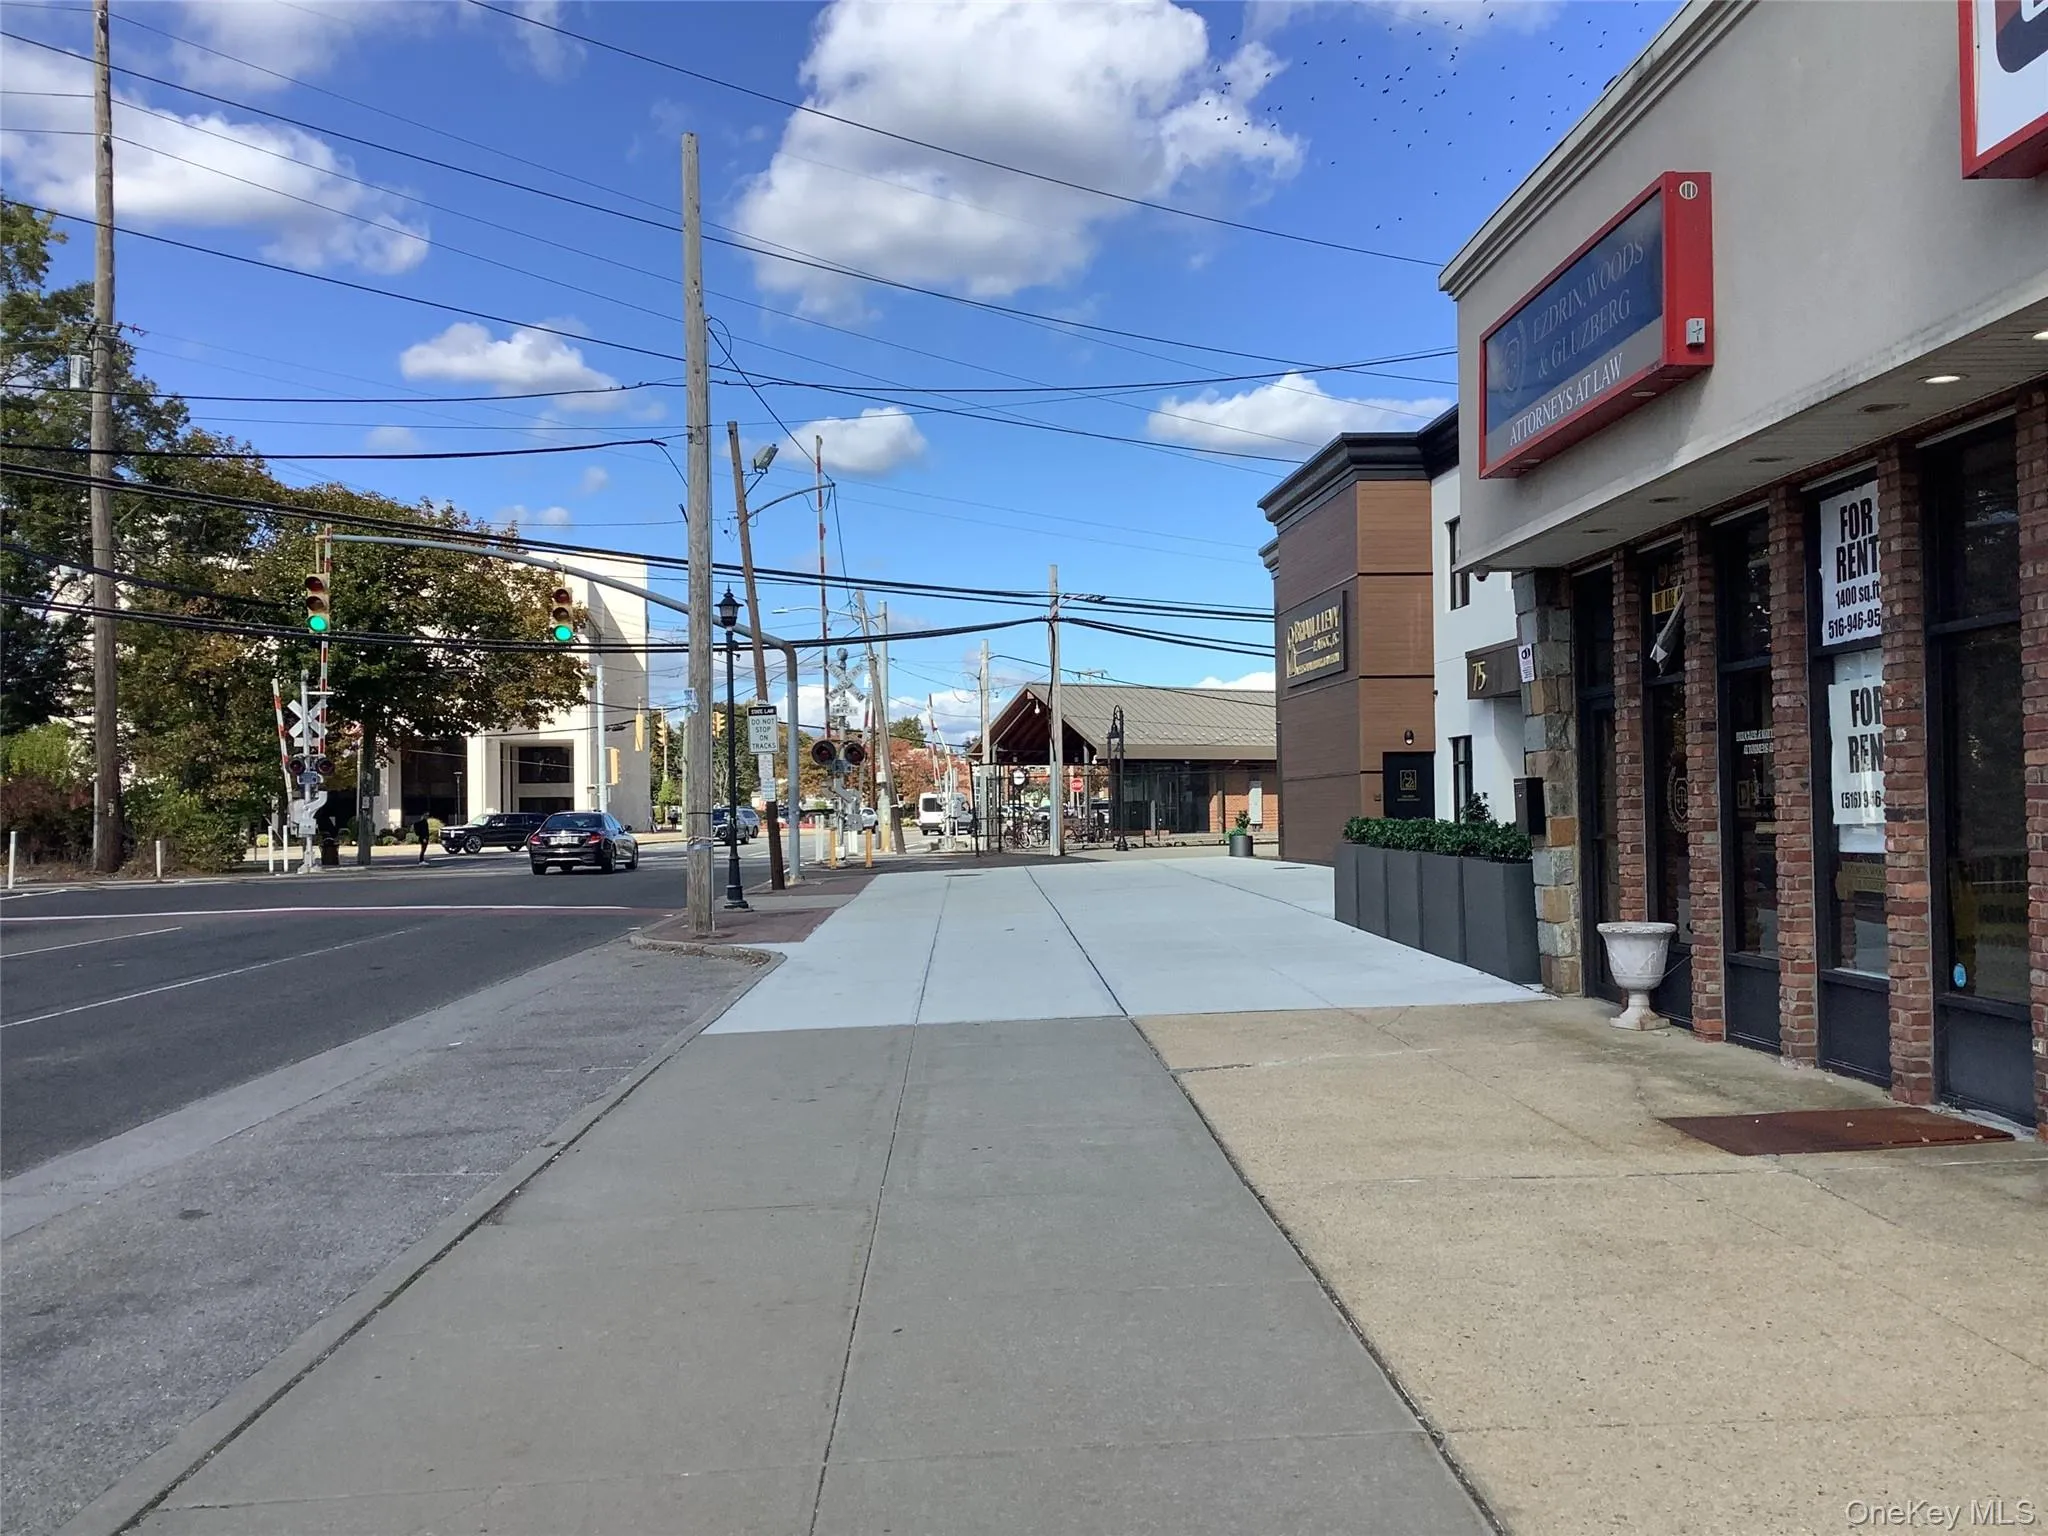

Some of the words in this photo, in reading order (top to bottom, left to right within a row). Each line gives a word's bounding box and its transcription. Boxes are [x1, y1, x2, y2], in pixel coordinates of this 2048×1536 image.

[1533, 287, 1587, 345] EZDRIN,
[1587, 239, 1645, 299] WOODS
[1538, 356, 1548, 379] &
[1552, 288, 1631, 369] GLUZBERG
[1509, 387, 1573, 446] ATTORNEYS
[1575, 373, 1591, 405] AT
[1593, 352, 1623, 392] LAW
[1840, 498, 1873, 543] FOR
[1836, 535, 1879, 584] RENT
[1835, 586, 1857, 609] 1400
[1828, 608, 1881, 640] 516-946-95
[1472, 661, 1486, 691] 75
[752, 742, 776, 750] TRACKS
[1848, 733, 1884, 774] REN
[1841, 791, 1862, 809] (516)
